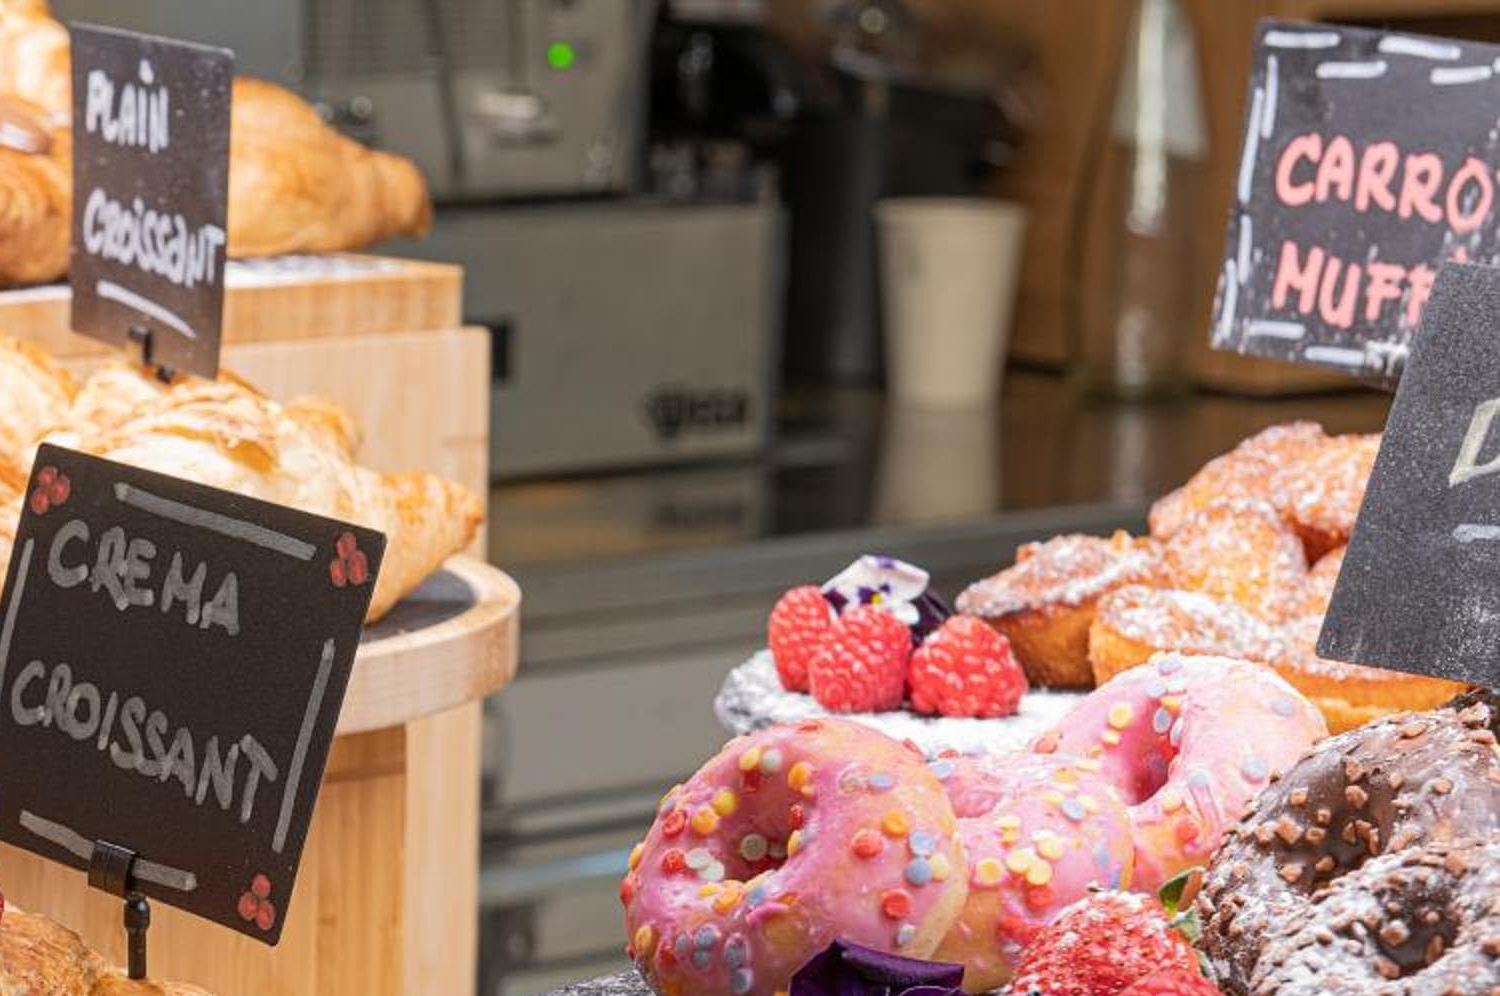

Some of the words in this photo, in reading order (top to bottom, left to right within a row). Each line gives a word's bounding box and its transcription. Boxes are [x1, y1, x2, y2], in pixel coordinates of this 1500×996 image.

[1275, 133, 1500, 234] CARRO
[1273, 240, 1466, 328] MUFF
[48, 520, 240, 635] CREMA
[12, 661, 278, 823] CROISSANT
